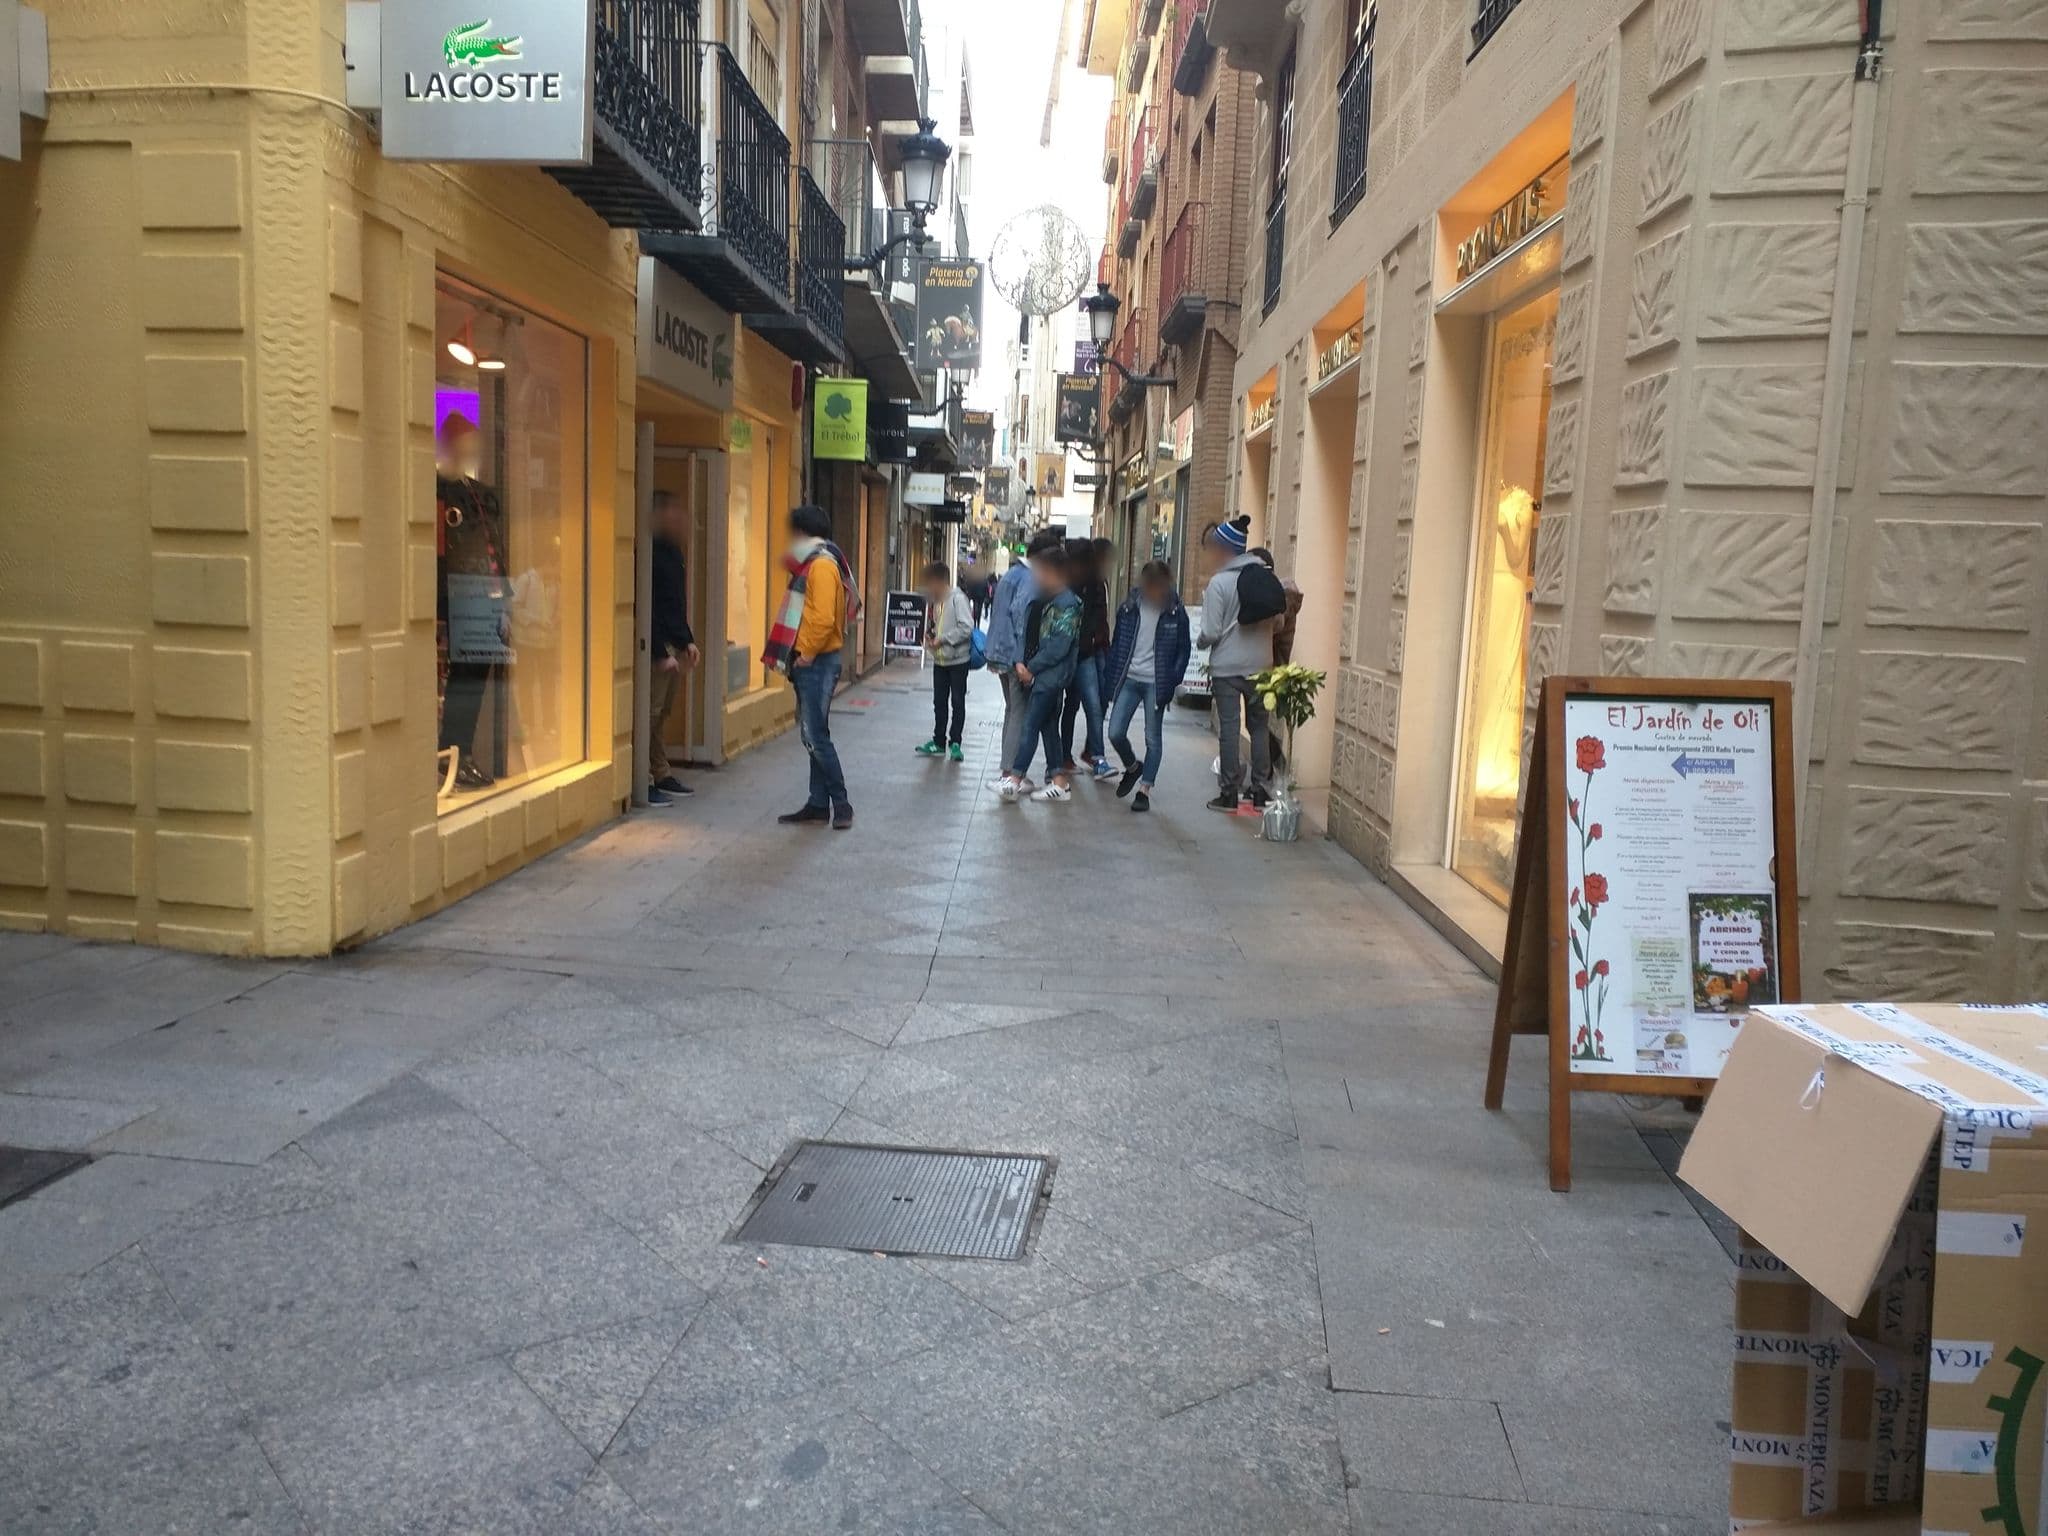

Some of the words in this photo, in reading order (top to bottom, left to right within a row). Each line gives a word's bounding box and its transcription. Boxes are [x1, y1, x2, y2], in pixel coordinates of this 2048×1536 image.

[404, 71, 563, 101] LACOSTE
[937, 277, 974, 288] Navidad
[655, 304, 708, 369] LACOSTE
[1607, 705, 1626, 728] El
[1632, 705, 1692, 731] Jardín
[1702, 708, 1724, 731] de
[1733, 708, 1760, 732] Oli
[1808, 1374, 1832, 1515] MONTEPICAZA
